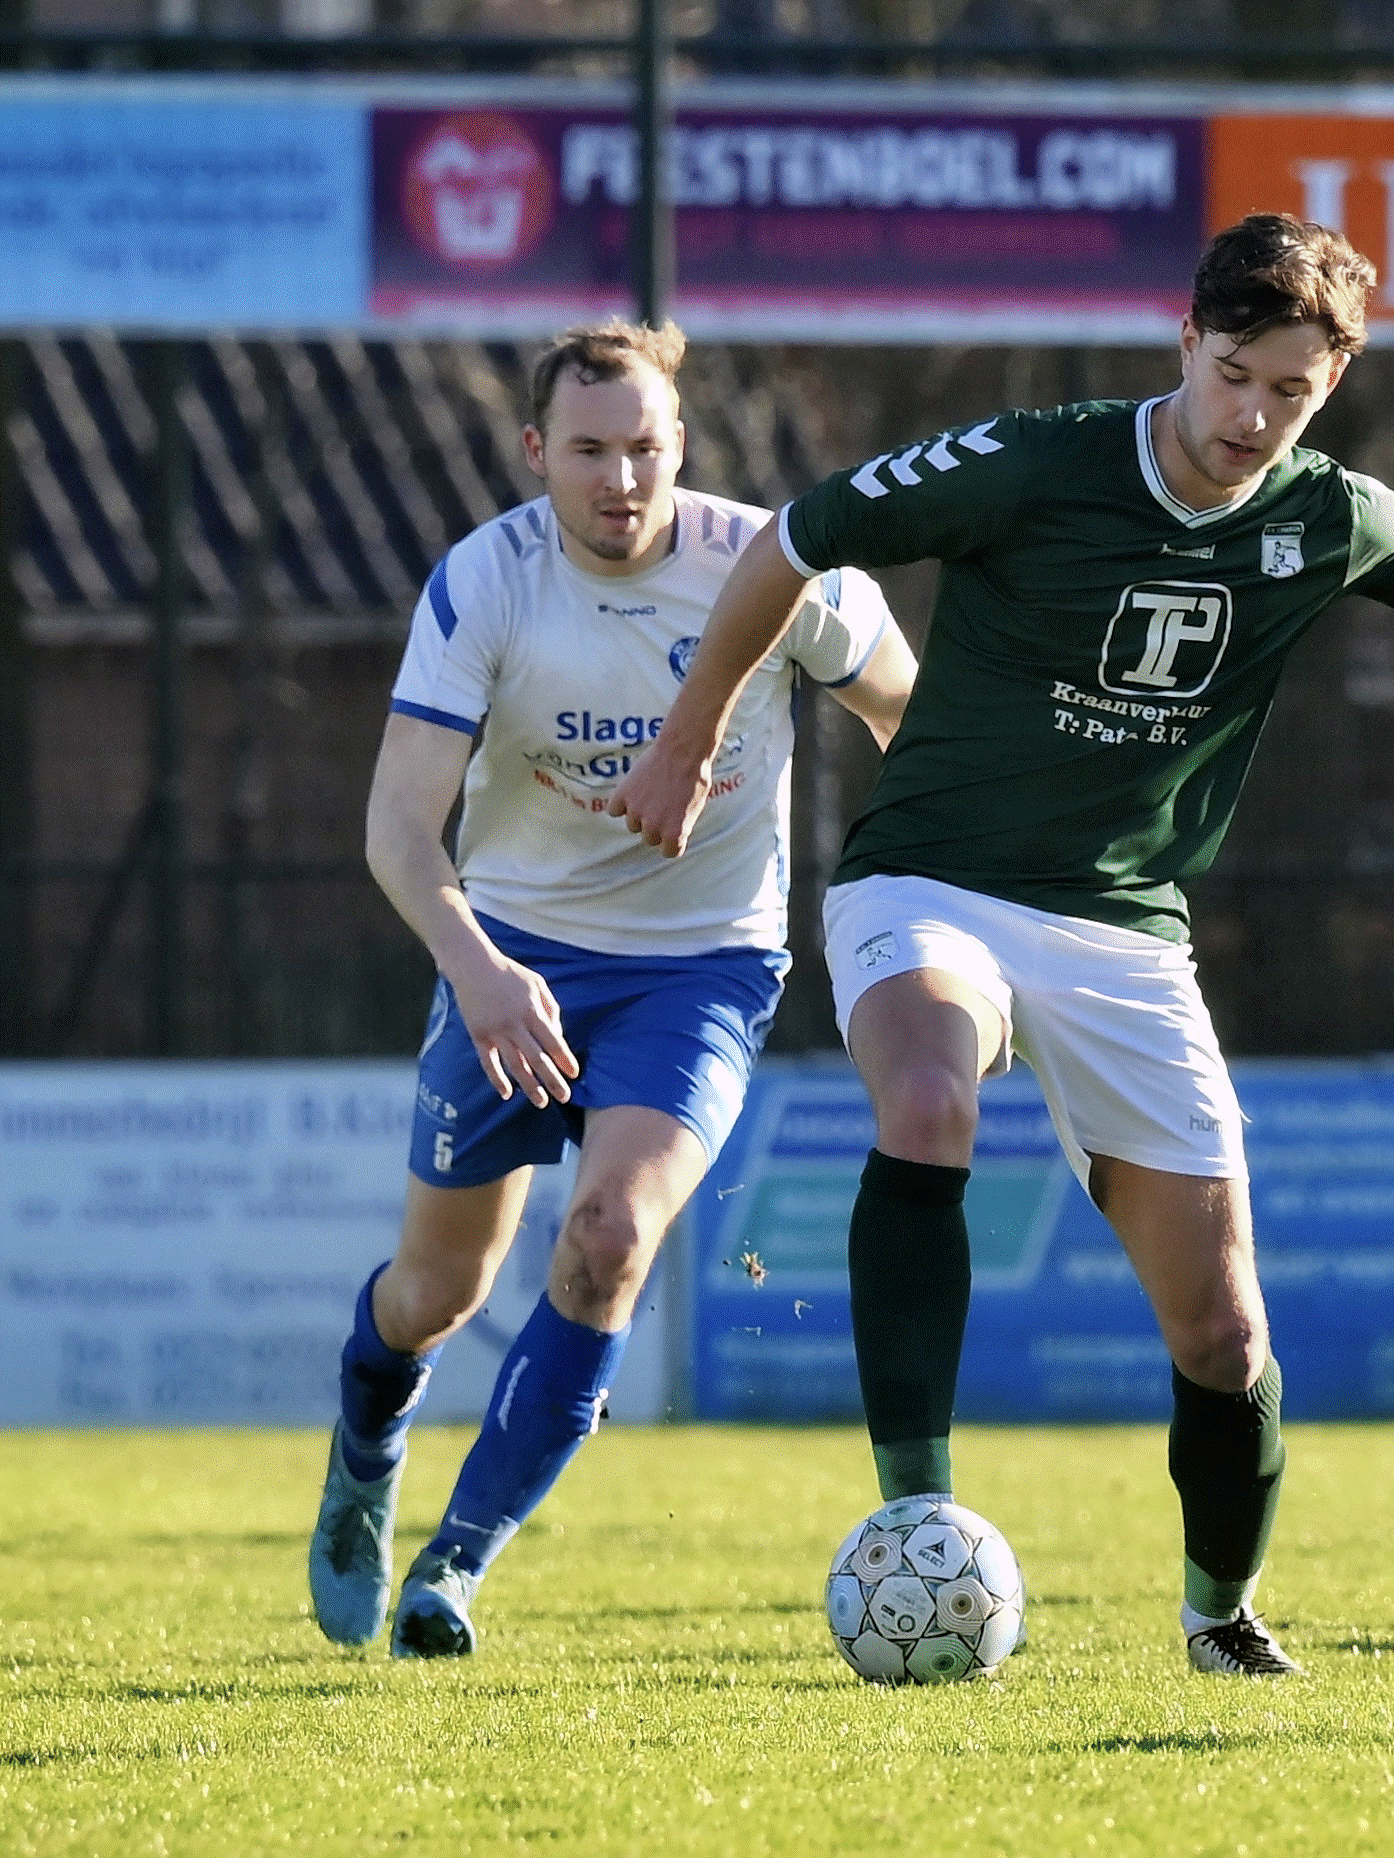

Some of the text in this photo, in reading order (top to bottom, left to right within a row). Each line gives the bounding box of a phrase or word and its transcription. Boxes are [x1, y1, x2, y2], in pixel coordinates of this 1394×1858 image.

[562, 125, 1177, 208] FESTENBOEL.COM
[1146, 724, 1187, 746] B.V.
[434, 1131, 454, 1173] 5
[917, 1549, 945, 1569] SELECT
